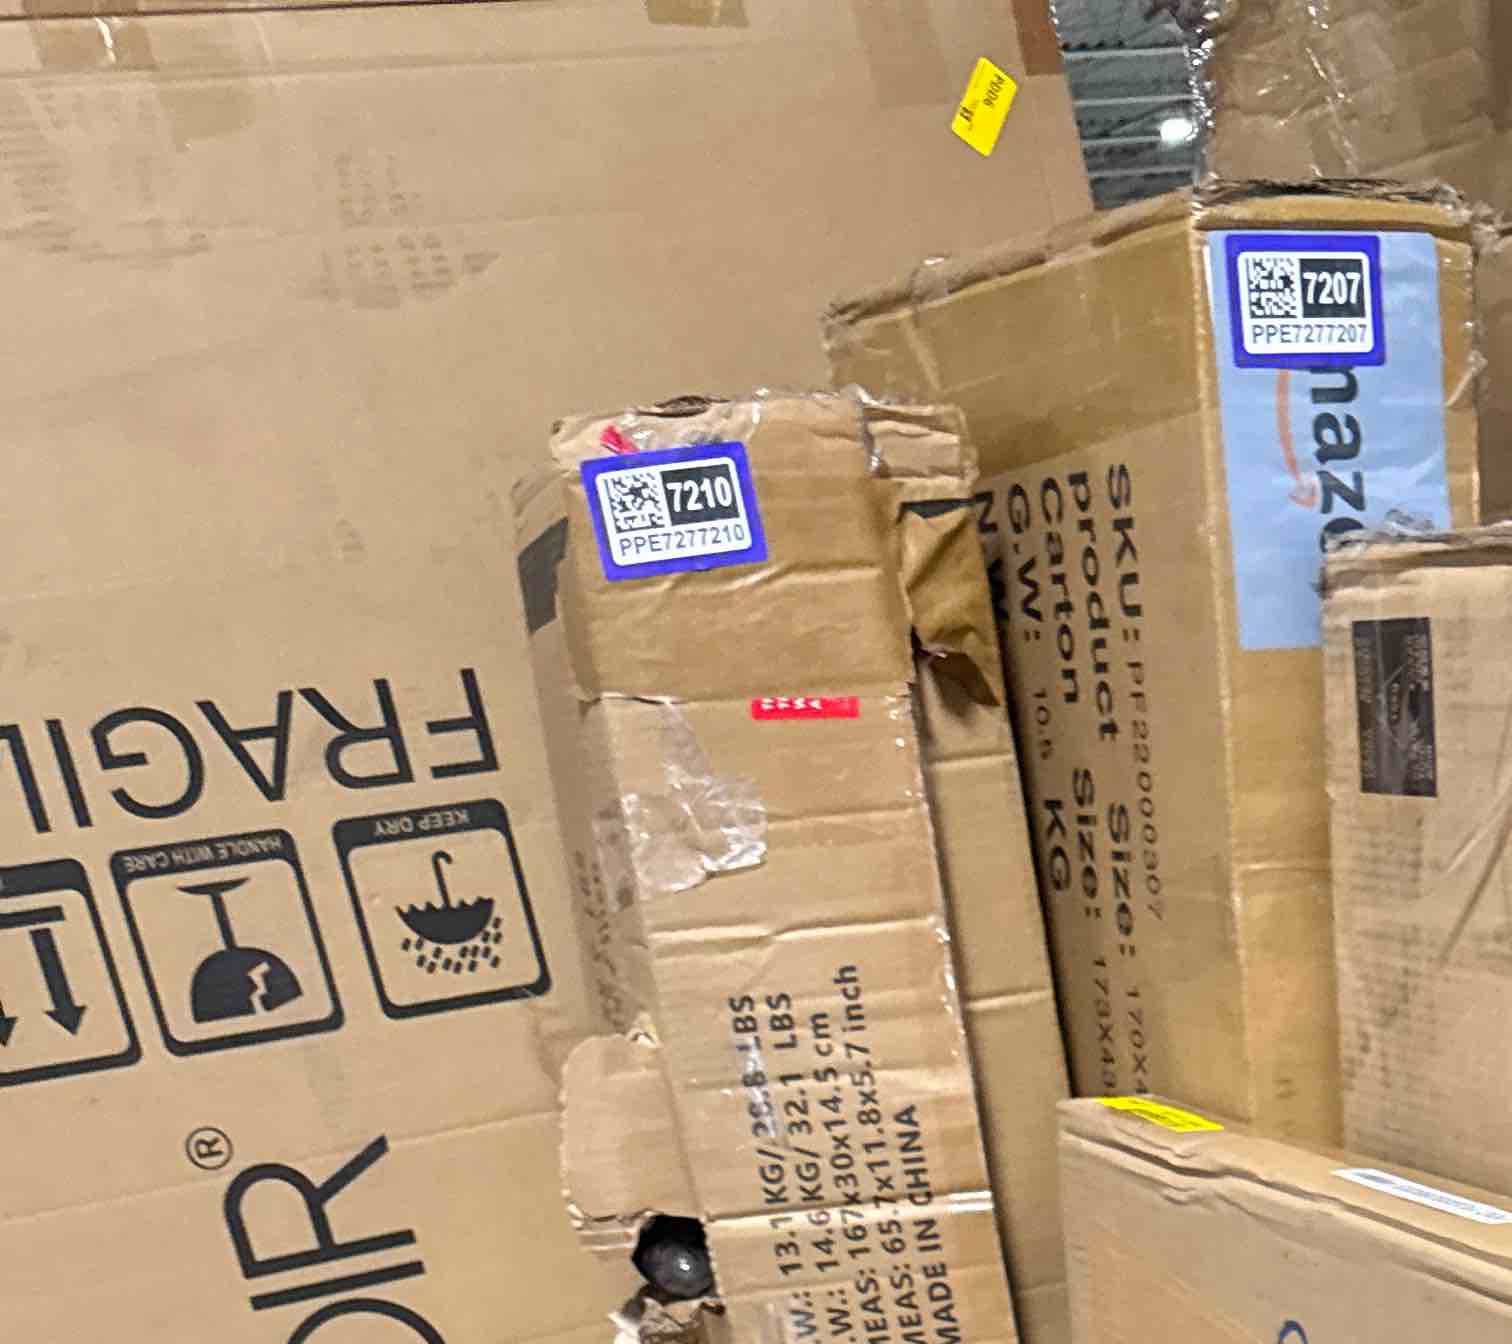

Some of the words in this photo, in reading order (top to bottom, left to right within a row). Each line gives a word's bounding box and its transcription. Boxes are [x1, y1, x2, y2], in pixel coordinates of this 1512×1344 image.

[1303, 271, 1362, 307] 7207
[1251, 324, 1368, 346] PPE7277207
[666, 476, 732, 513] 7210
[619, 524, 745, 557] PPE7277210
[1040, 478, 1080, 704] Carton
[1068, 471, 1120, 742] product
[1125, 987, 1150, 1097] 170X4
[374, 815, 422, 837] DRY
[1043, 799, 1071, 893] KG
[766, 992, 800, 1051] LBS
[833, 965, 867, 1034] inch
[808, 1013, 836, 1057] cm
[780, 1072, 813, 1136] 32.1
[893, 1104, 934, 1207] CHINA
[807, 1208, 841, 1272] 14.6
[912, 1219, 943, 1253] IN
